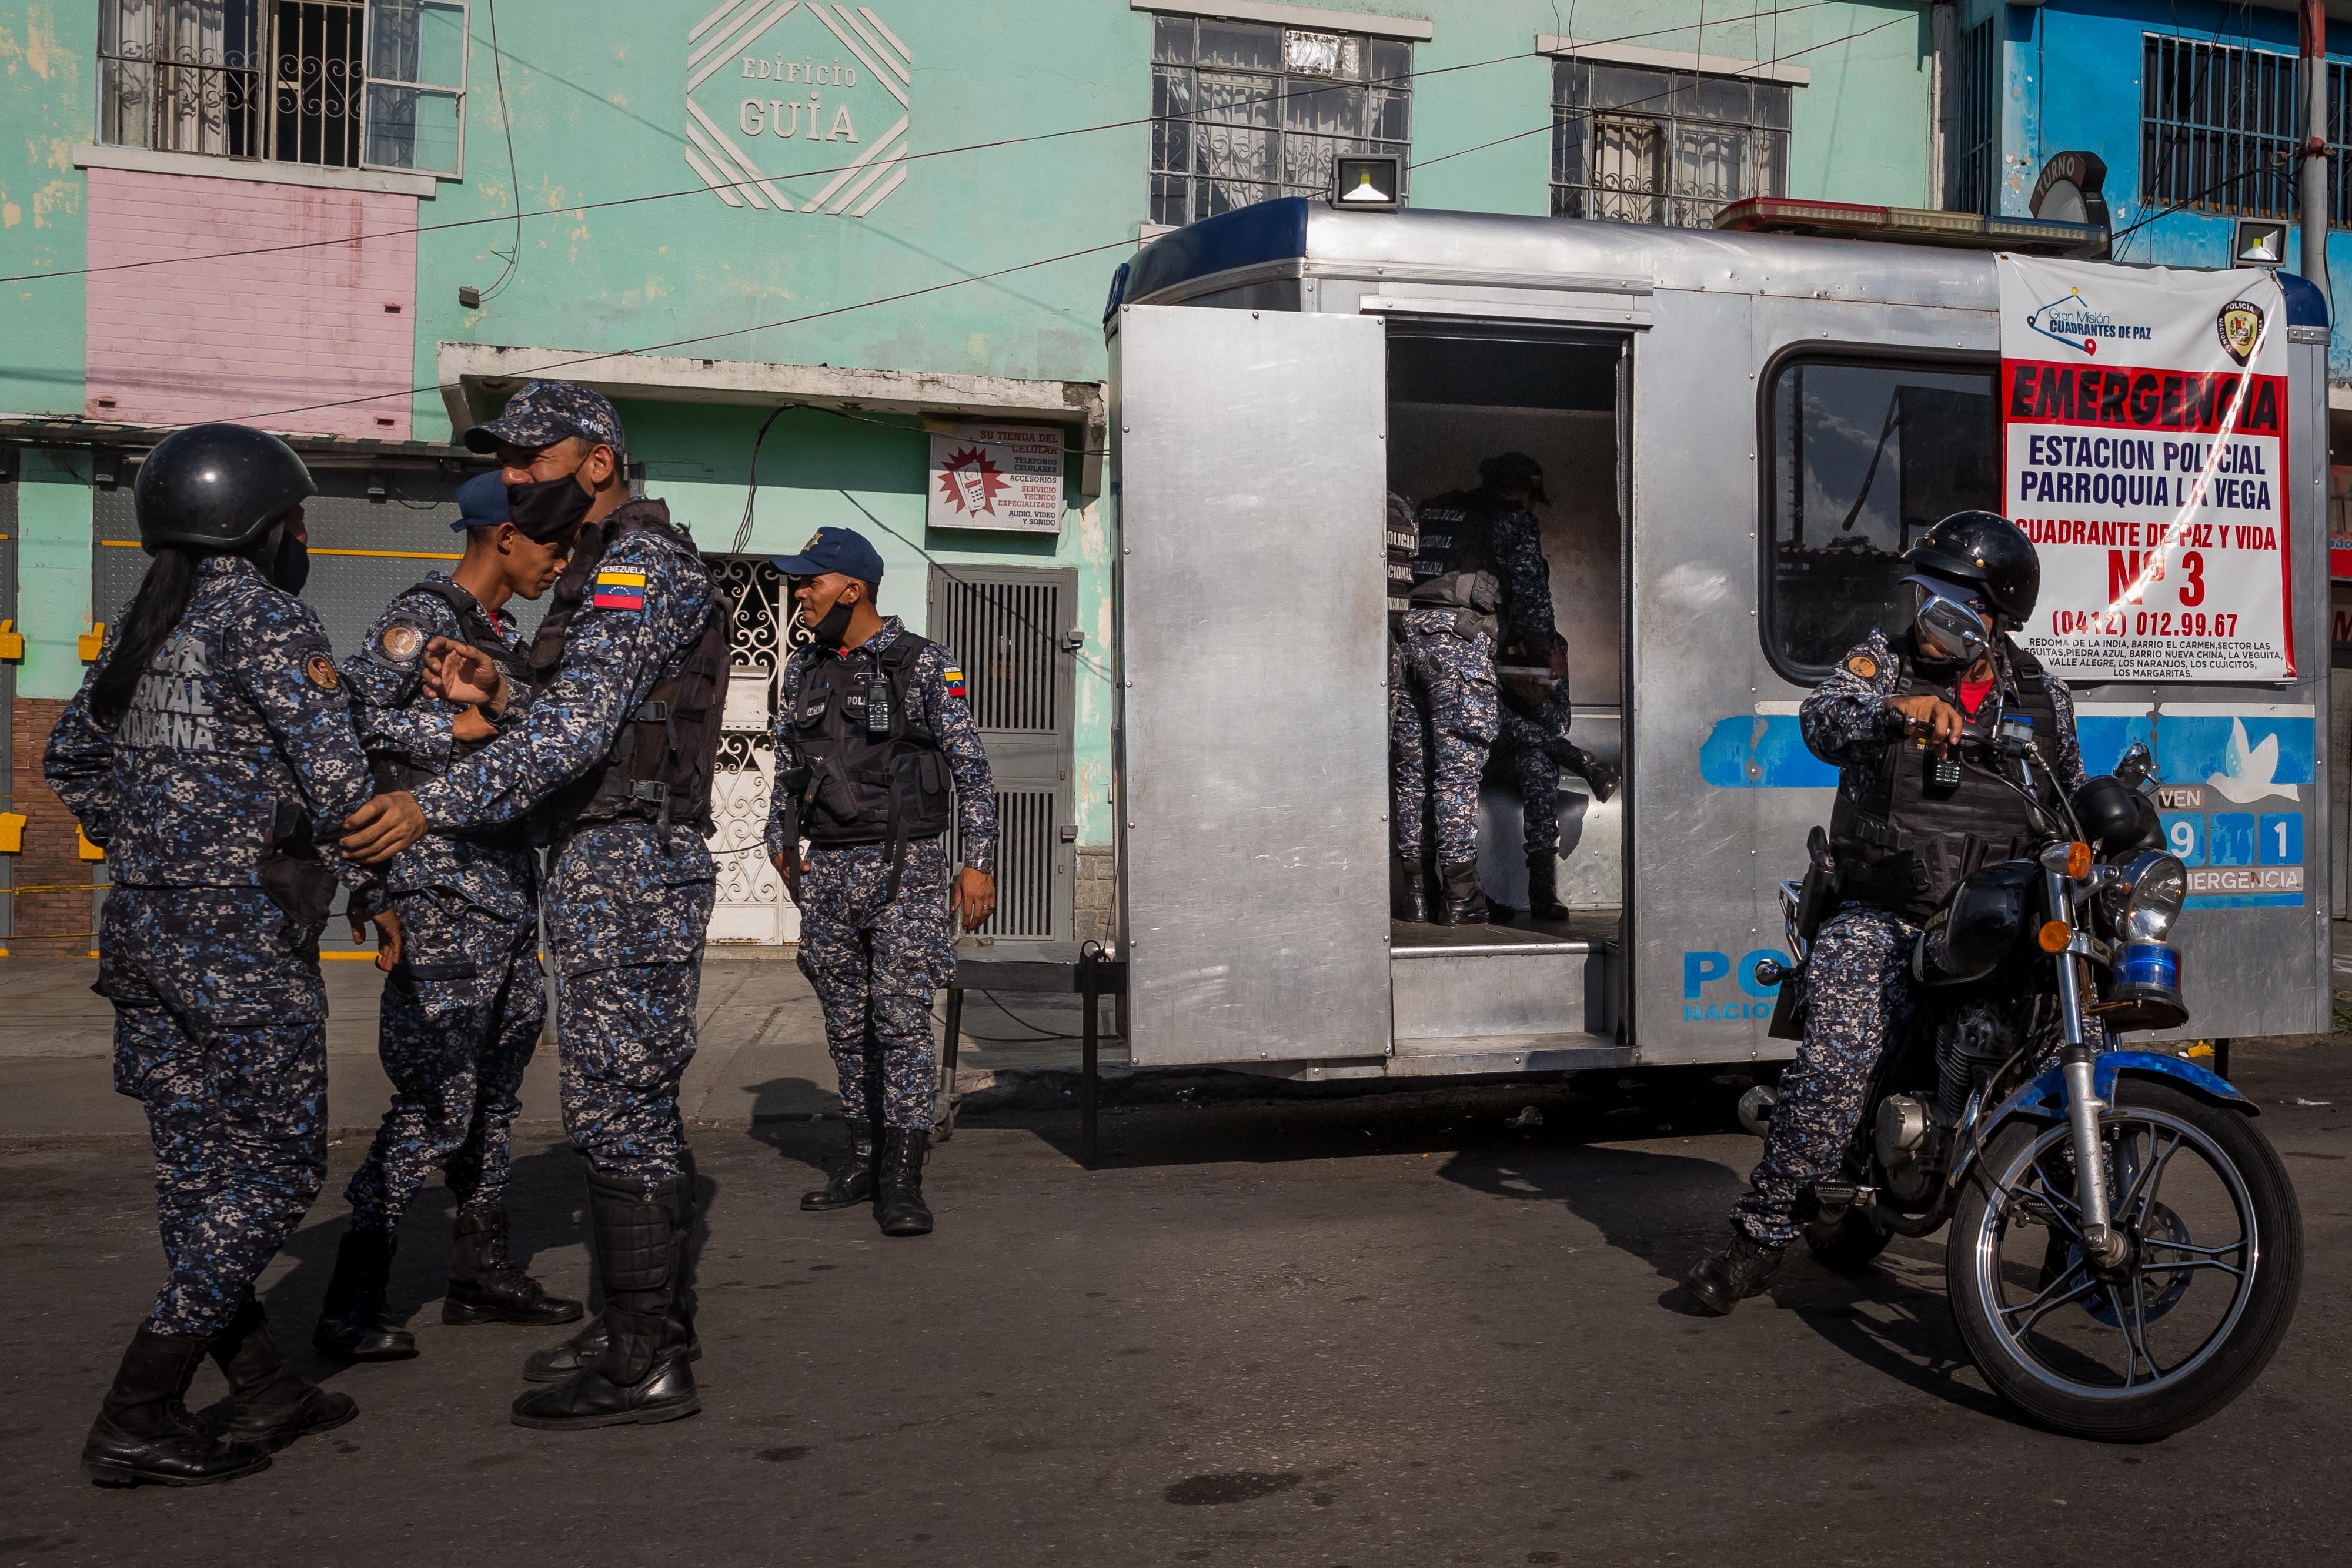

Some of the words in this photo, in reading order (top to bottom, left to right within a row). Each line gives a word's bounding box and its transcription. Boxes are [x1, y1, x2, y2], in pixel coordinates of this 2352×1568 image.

[2037, 156, 2074, 197] TURNO
[2049, 307, 2074, 322] Gran
[2077, 310, 2110, 325] Misión
[2049, 319, 2116, 338] CUADRANTES
[2118, 325, 2131, 339] DE
[2133, 326, 2151, 340] PAZ
[2010, 365, 2278, 431] EMERGENCIA
[581, 418, 603, 434] PNB
[980, 430, 994, 439] SU
[997, 432, 1036, 442] TIENDA
[1038, 433, 1058, 443] DEL
[1011, 444, 1058, 455] CELULAR
[2029, 434, 2154, 471] ESTACION
[2163, 441, 2266, 475] POLICIAL
[1014, 457, 1057, 466] TELEFONOS
[1014, 464, 1057, 473] CELULARES
[1010, 475, 1057, 483] ACCESORIOS
[2020, 471, 2169, 508] PARROQUIA
[2176, 479, 2208, 507] LA
[2214, 478, 2271, 511] VEGA
[998, 500, 1056, 509] ESPECIALIZADO
[1387, 530, 1415, 550] OLICIA
[2015, 518, 2141, 547] CUADRANTE
[2146, 523, 2171, 548] DE
[2179, 523, 2214, 548] PAZ
[2214, 525, 2230, 549] Y
[2236, 525, 2277, 551] VIDA
[600, 566, 646, 575] VENEZUELA
[1388, 564, 1413, 581] CIONAL
[2179, 551, 2205, 607] 3
[2052, 610, 2126, 638] (0412)
[2136, 611, 2238, 638] 012.99.67
[2029, 638, 2070, 647] REDOMA
[2103, 640, 2129, 650] INDIA,
[2132, 640, 2164, 648] BARRIO
[2102, 650, 2127, 658] AZUL,
[2165, 650, 2194, 658] NUEVA
[2197, 651, 2226, 660] CHINA,
[2242, 651, 2283, 660] VEGUITA,
[2049, 658, 2077, 666] VALLE
[2079, 658, 2116, 668] ALEGRE,
[2119, 659, 2134, 667] LOS
[2137, 660, 2188, 669] NARANJOS,
[2209, 660, 2257, 670] CUJICITOS,
[131, 674, 215, 716] ONAL
[2160, 790, 2201, 807] VEN
[2170, 821, 2194, 858] 9
[2273, 821, 2287, 857] 1
[1683, 1002, 1776, 1022] NACIO
